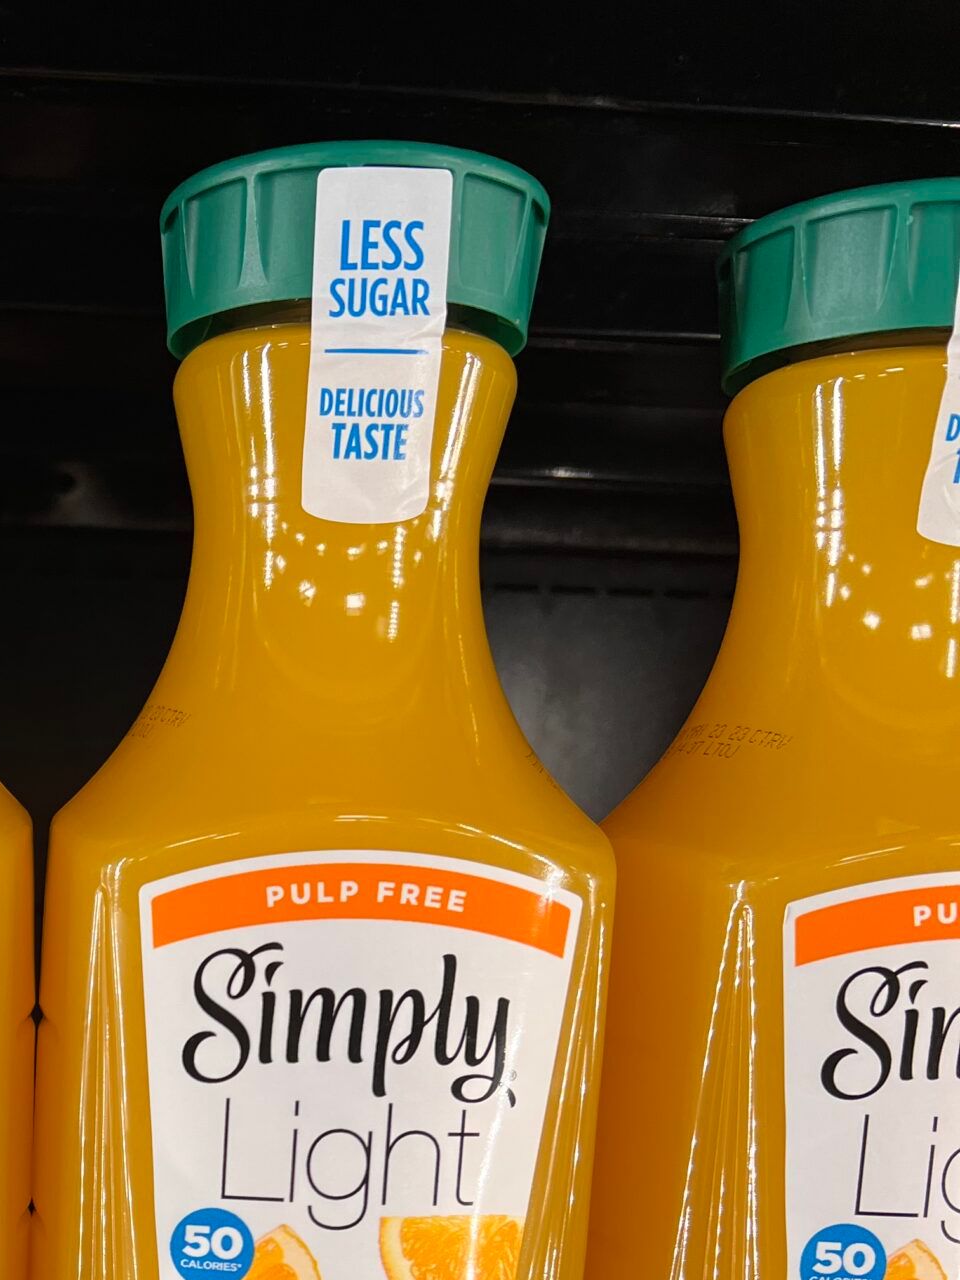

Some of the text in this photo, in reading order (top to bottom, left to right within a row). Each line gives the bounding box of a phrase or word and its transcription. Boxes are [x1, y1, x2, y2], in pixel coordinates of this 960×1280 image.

[339, 220, 425, 271] LESS
[329, 278, 430, 317] SUGAR
[319, 388, 425, 418] DELICIOUS
[332, 423, 408, 460] TASTE
[266, 880, 467, 912] PULP FREE
[182, 941, 515, 1107] Simply
[220, 1098, 479, 1231] Light
[181, 1225, 243, 1257] 50
[811, 1241, 875, 1275] 50
